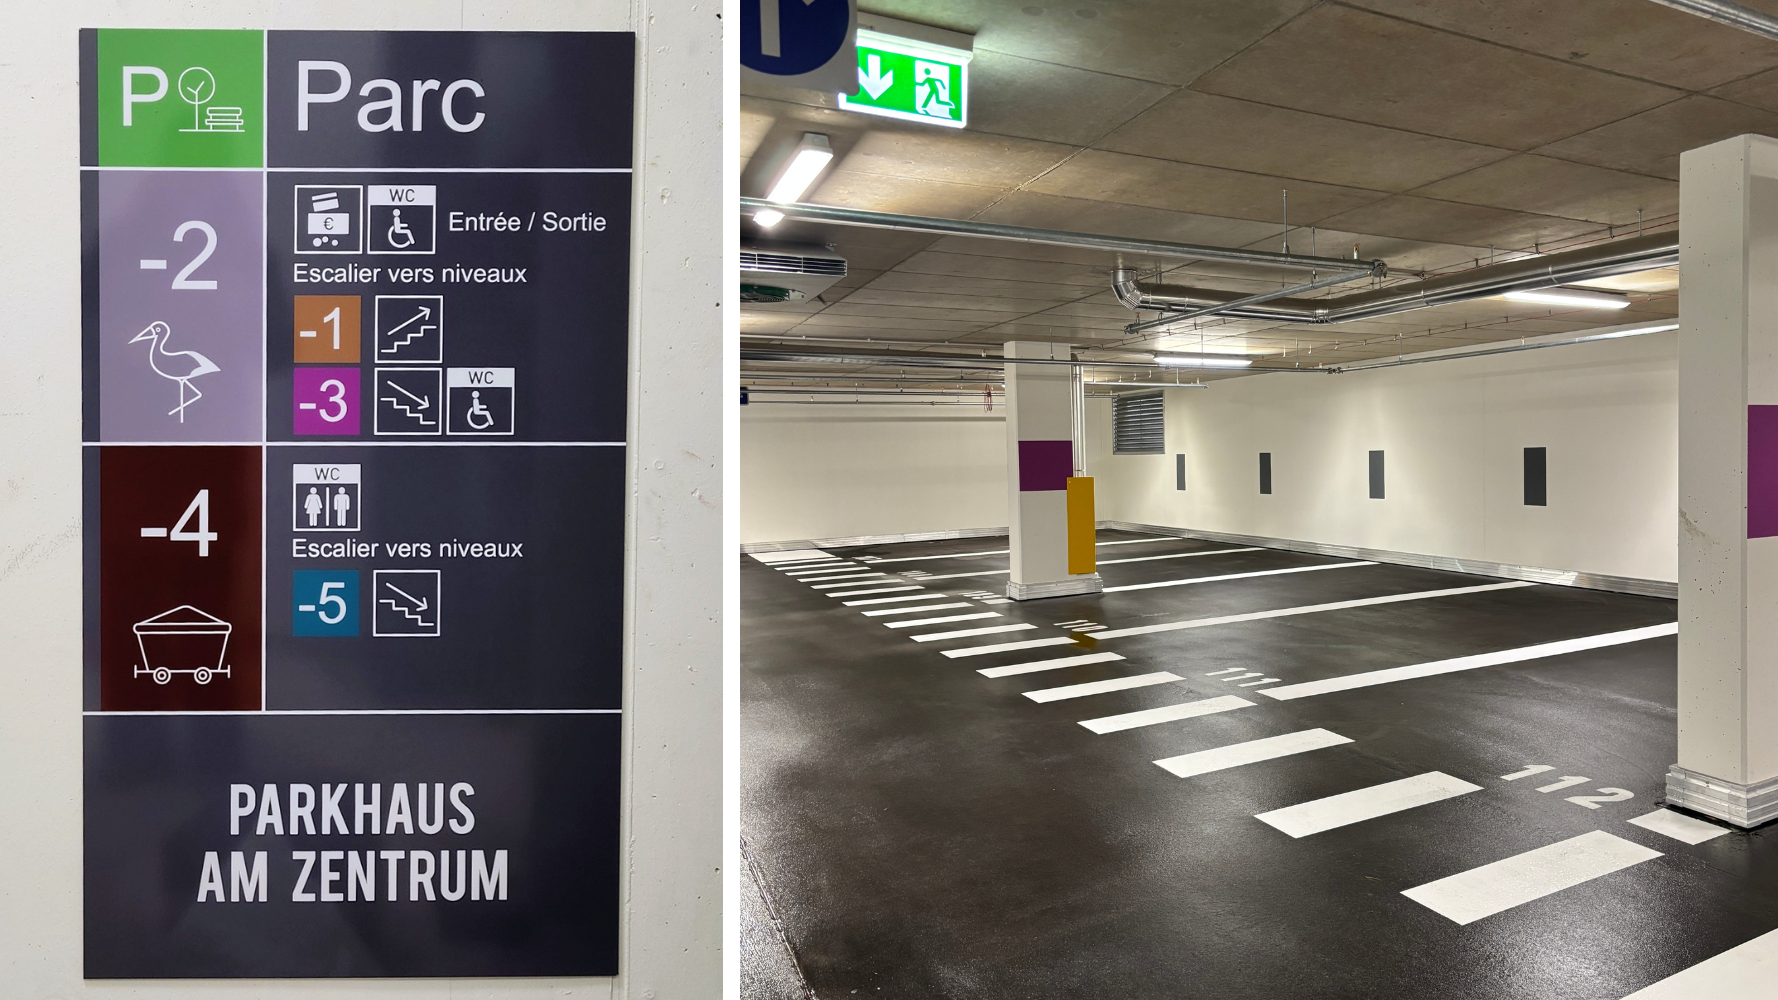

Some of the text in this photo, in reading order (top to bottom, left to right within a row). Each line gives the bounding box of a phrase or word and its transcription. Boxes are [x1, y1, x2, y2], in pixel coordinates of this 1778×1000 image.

[123, 66, 168, 127] P
[298, 61, 486, 133] Parc
[389, 188, 415, 203] WC
[449, 211, 521, 232] Entrée
[543, 211, 607, 232] Sortie
[140, 221, 218, 290] -2
[293, 262, 527, 283] Escalier vers niveaux
[300, 307, 341, 350] -1
[468, 371, 494, 385] WC
[299, 379, 347, 423] -3
[314, 467, 340, 481] WC
[140, 489, 218, 557] -4
[292, 538, 523, 558] Escalier vers niveaux
[298, 581, 347, 624] -5
[1204, 667, 1282, 688] 111
[230, 782, 476, 835] PARKHAUS
[1500, 764, 1635, 810] 112
[197, 849, 508, 903] AM ZENTRUM
